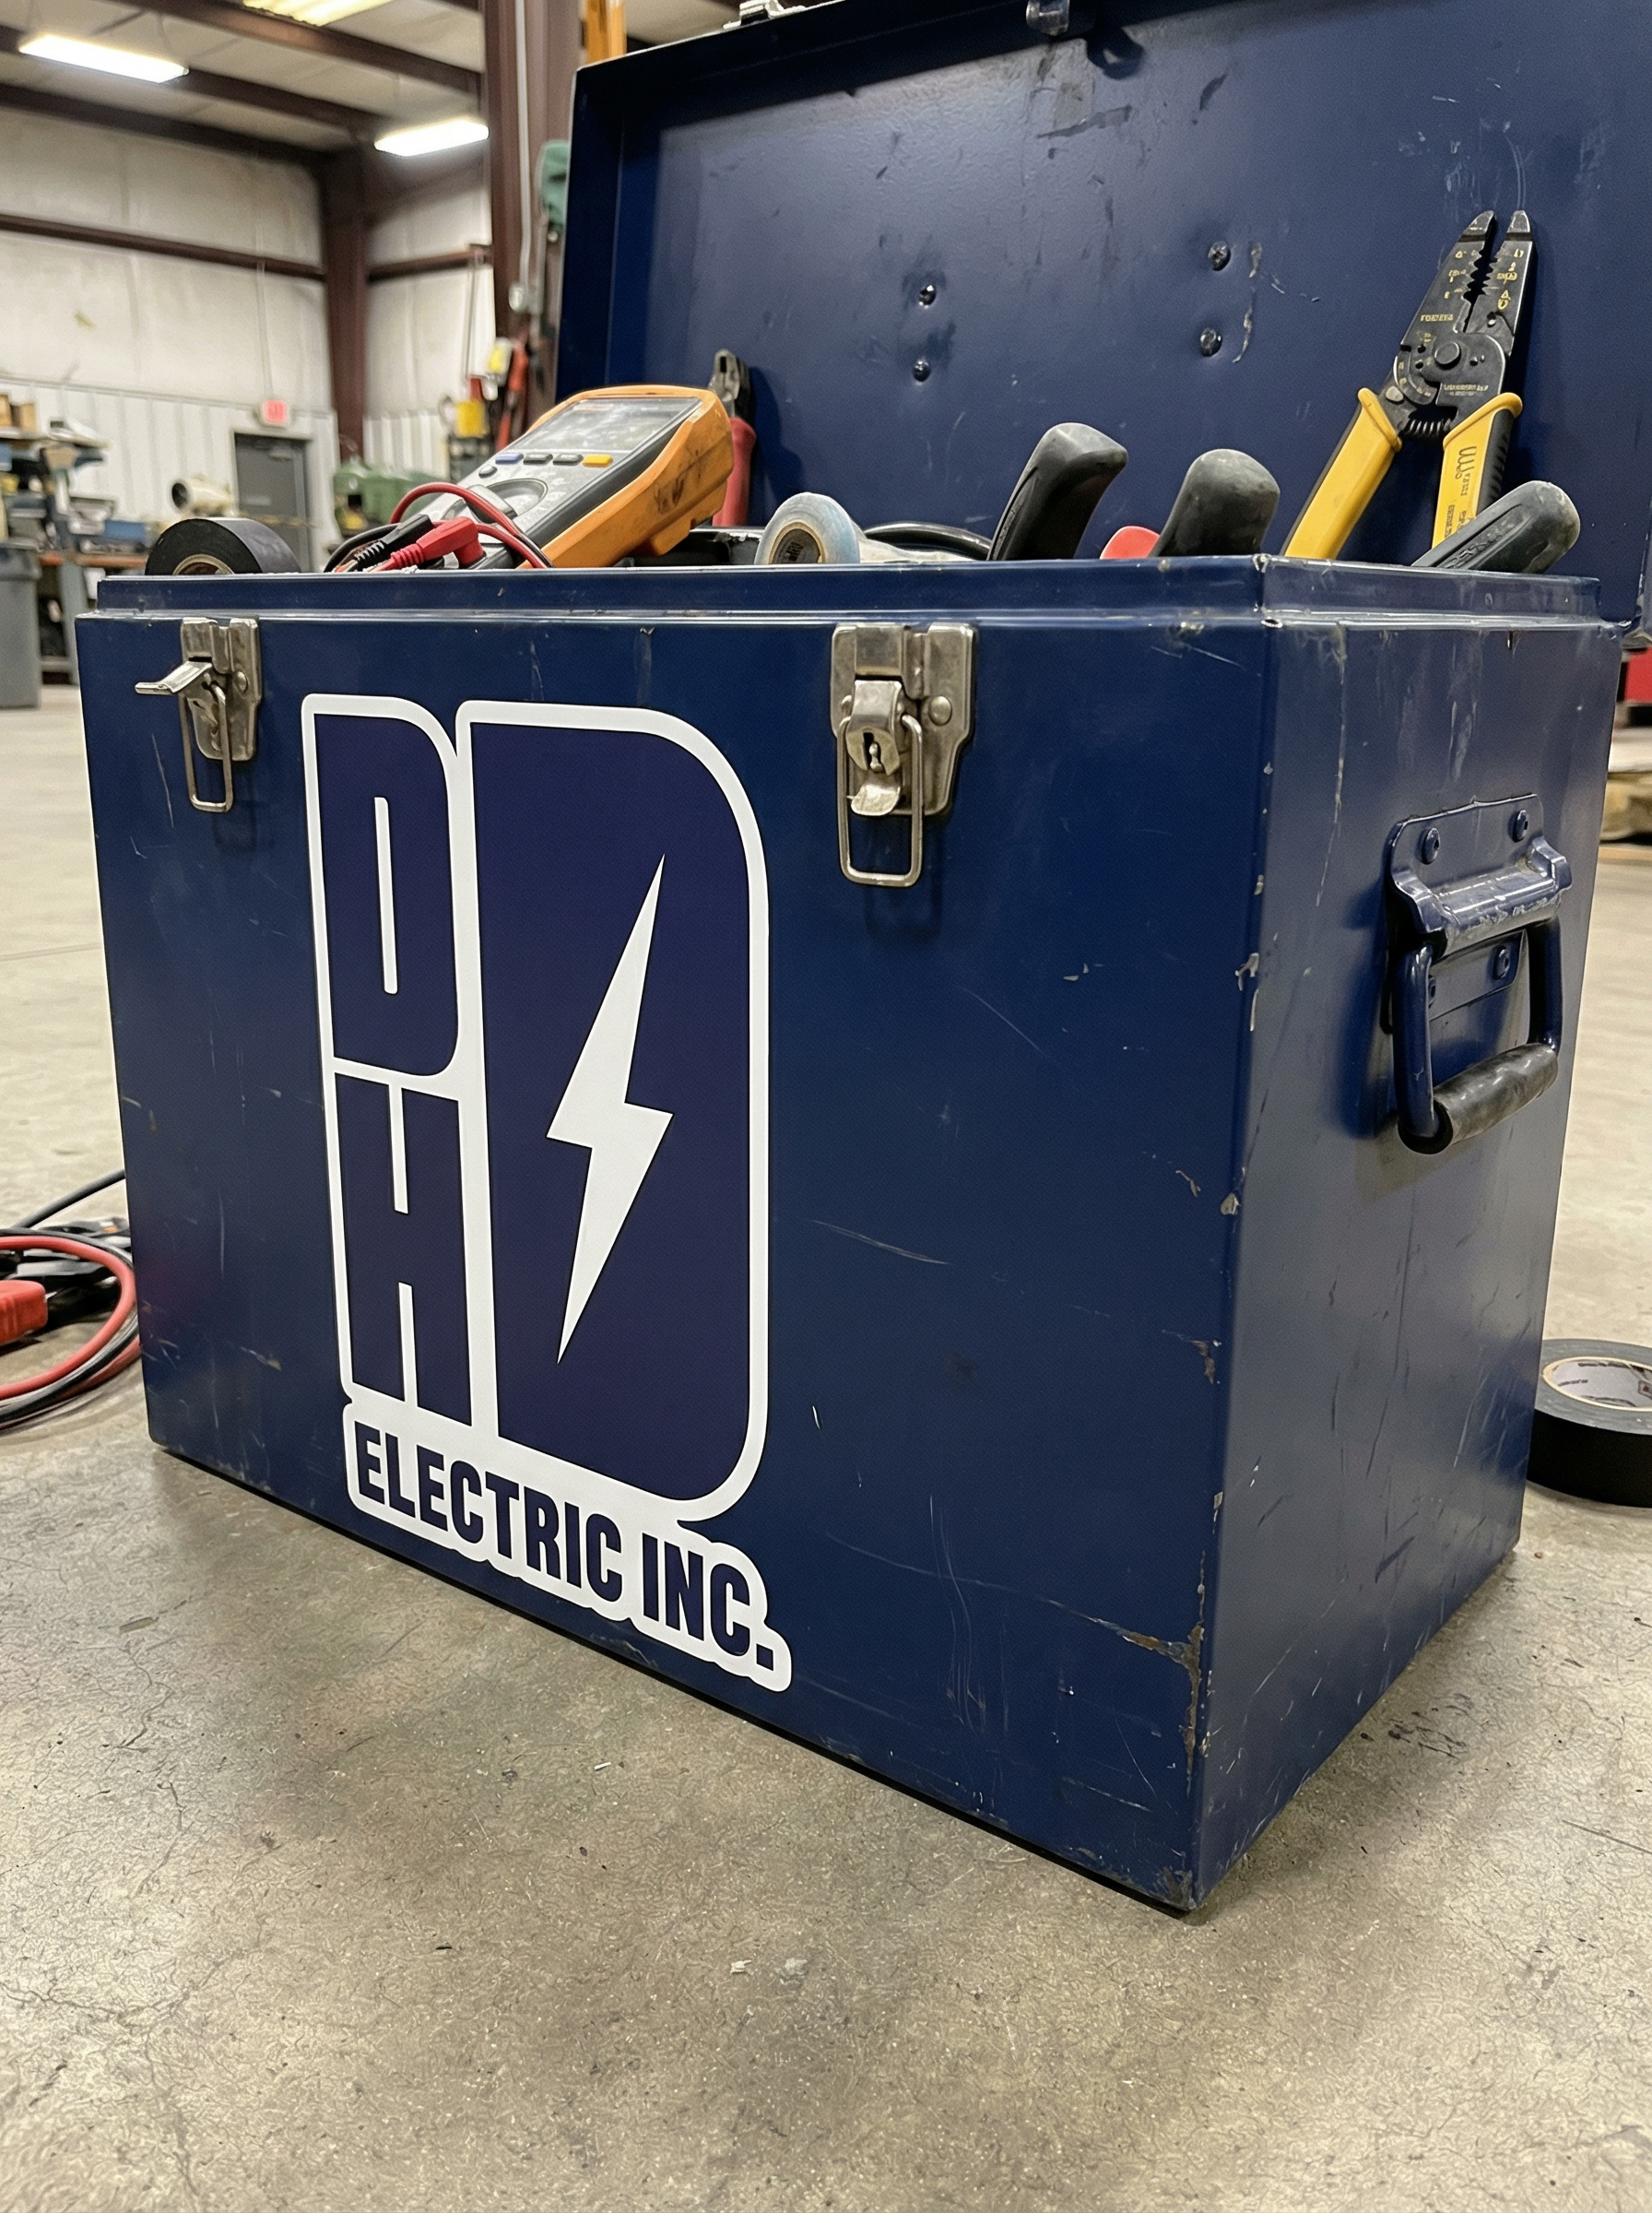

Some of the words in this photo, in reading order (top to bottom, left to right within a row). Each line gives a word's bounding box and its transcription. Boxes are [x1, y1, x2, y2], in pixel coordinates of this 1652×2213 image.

[313, 713, 459, 1076] D
[335, 1072, 472, 1427] H
[354, 1421, 623, 1603] ELECTRIC
[642, 1533, 774, 1672] INC.
